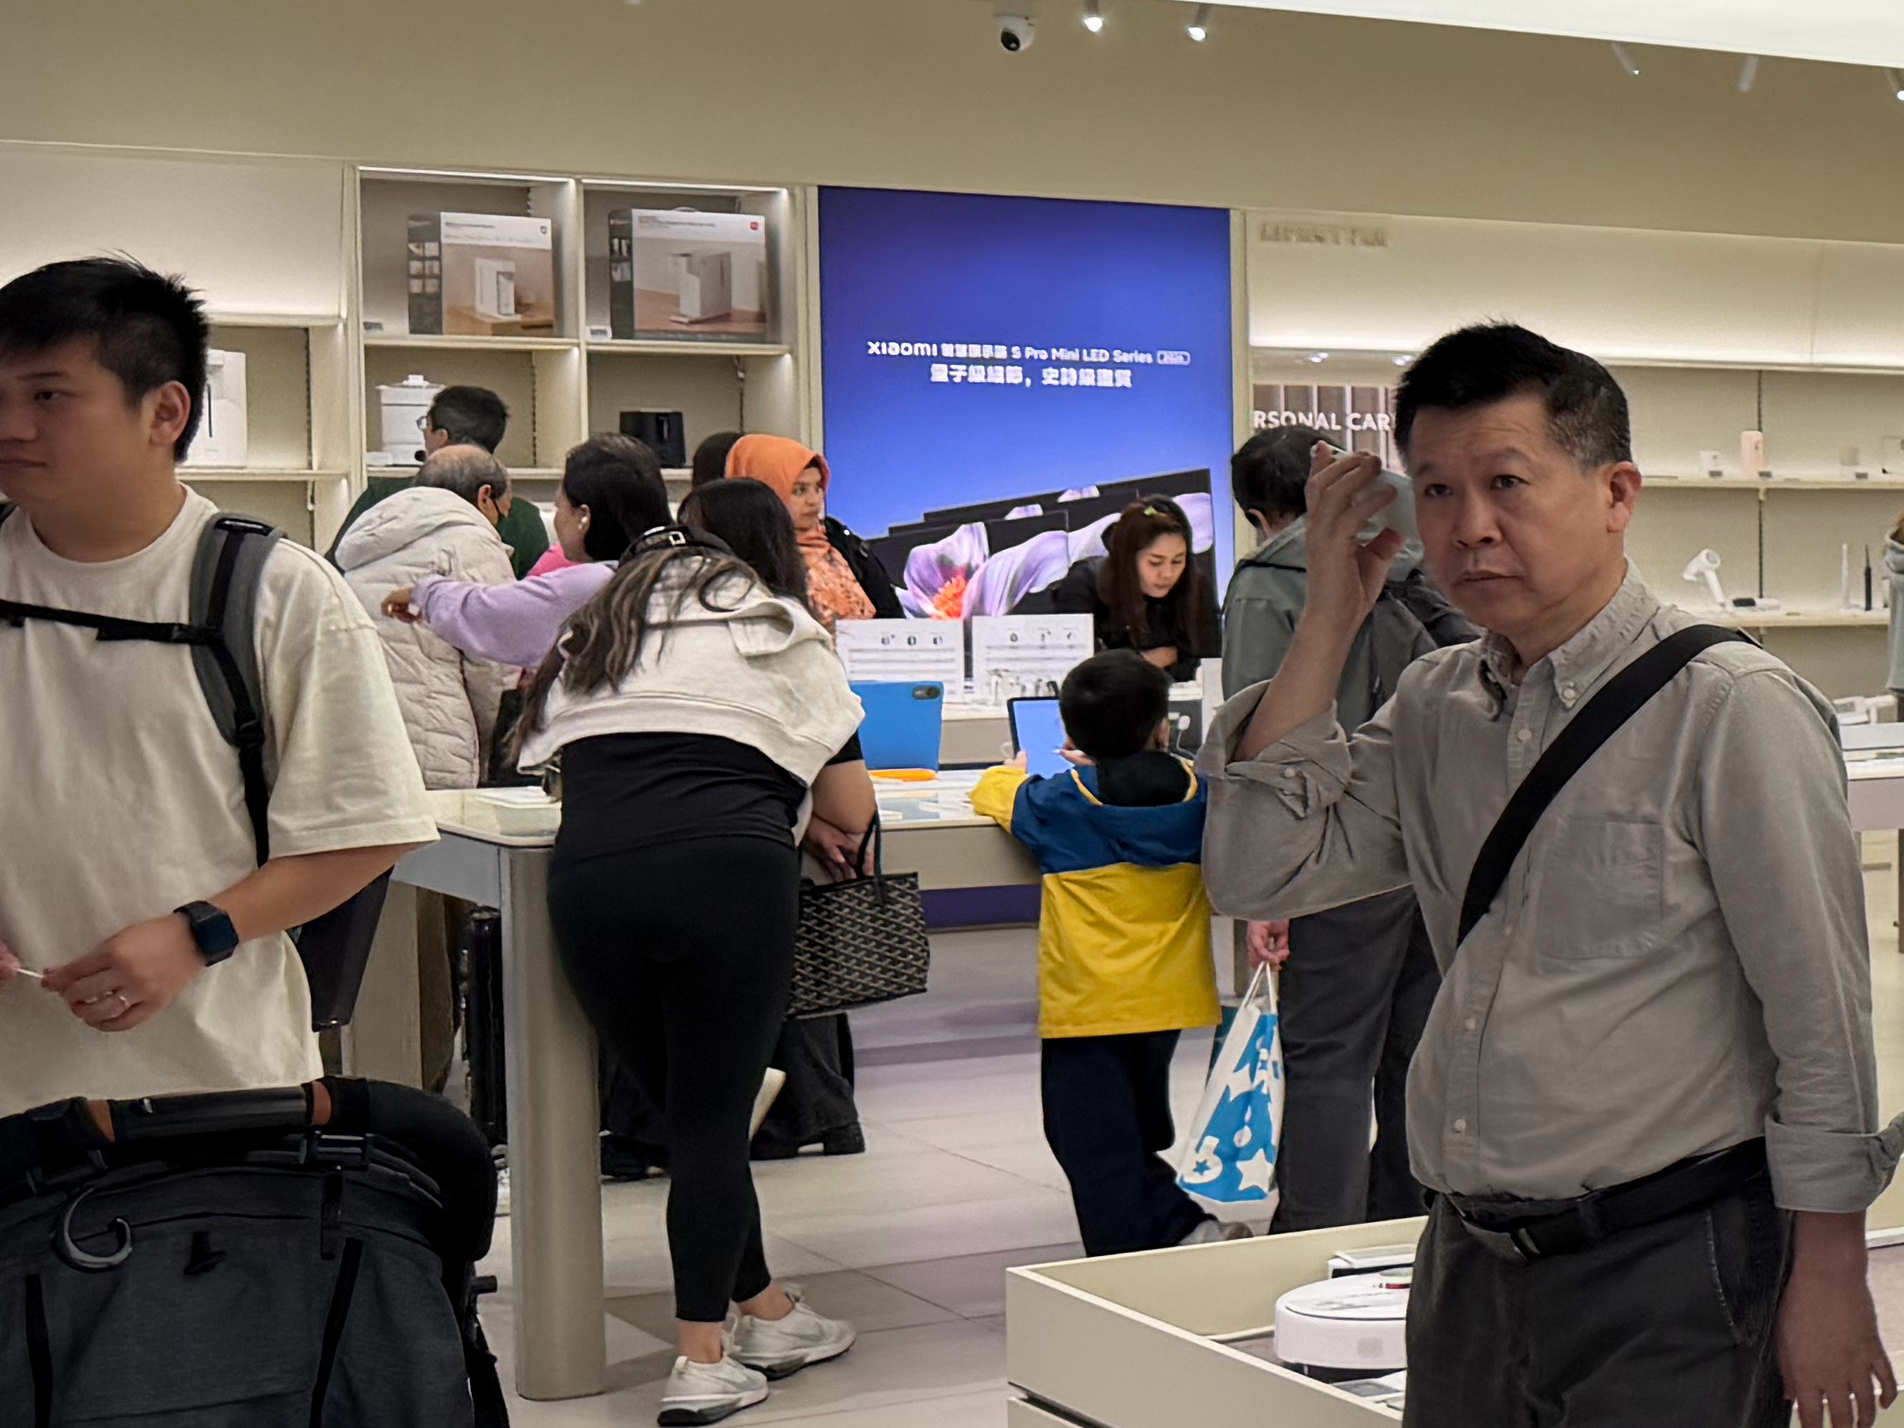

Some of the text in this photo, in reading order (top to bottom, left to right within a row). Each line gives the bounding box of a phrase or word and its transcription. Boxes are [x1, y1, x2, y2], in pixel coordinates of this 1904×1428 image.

[1025, 346, 1048, 360] Pro
[1051, 347, 1079, 361] Mini
[1082, 348, 1110, 362] LED
[1112, 349, 1153, 364] Series
[1252, 410, 1394, 432] RSONAL CAR
